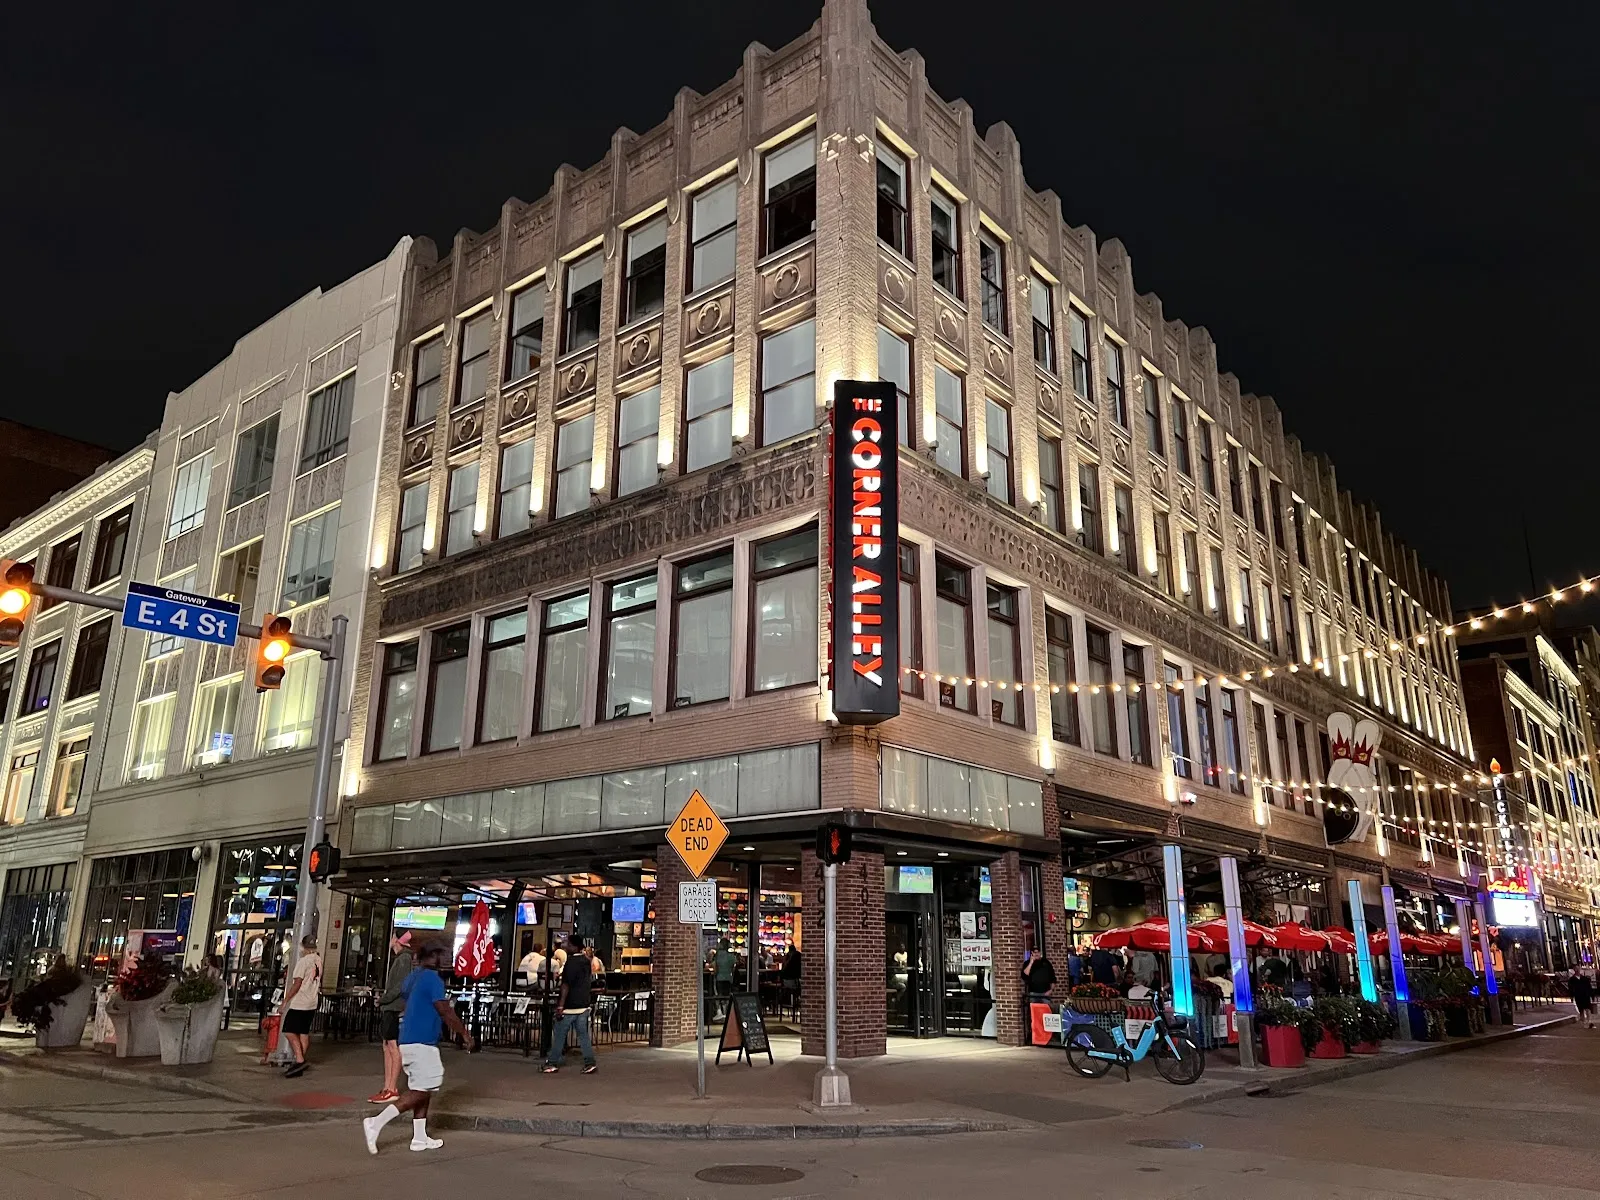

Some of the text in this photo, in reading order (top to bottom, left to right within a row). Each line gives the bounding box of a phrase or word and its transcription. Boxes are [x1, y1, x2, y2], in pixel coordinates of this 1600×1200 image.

[852, 398, 882, 412] THE
[852, 417, 883, 687] CORNER ALLEY
[165, 590, 208, 607] Gateway
[138, 600, 228, 639] E. 4 St
[680, 817, 713, 832] DEAD
[685, 837, 709, 851] END
[682, 886, 712, 897] GARAGE
[683, 898, 712, 908] ACCESS
[688, 910, 707, 920] ONLY
